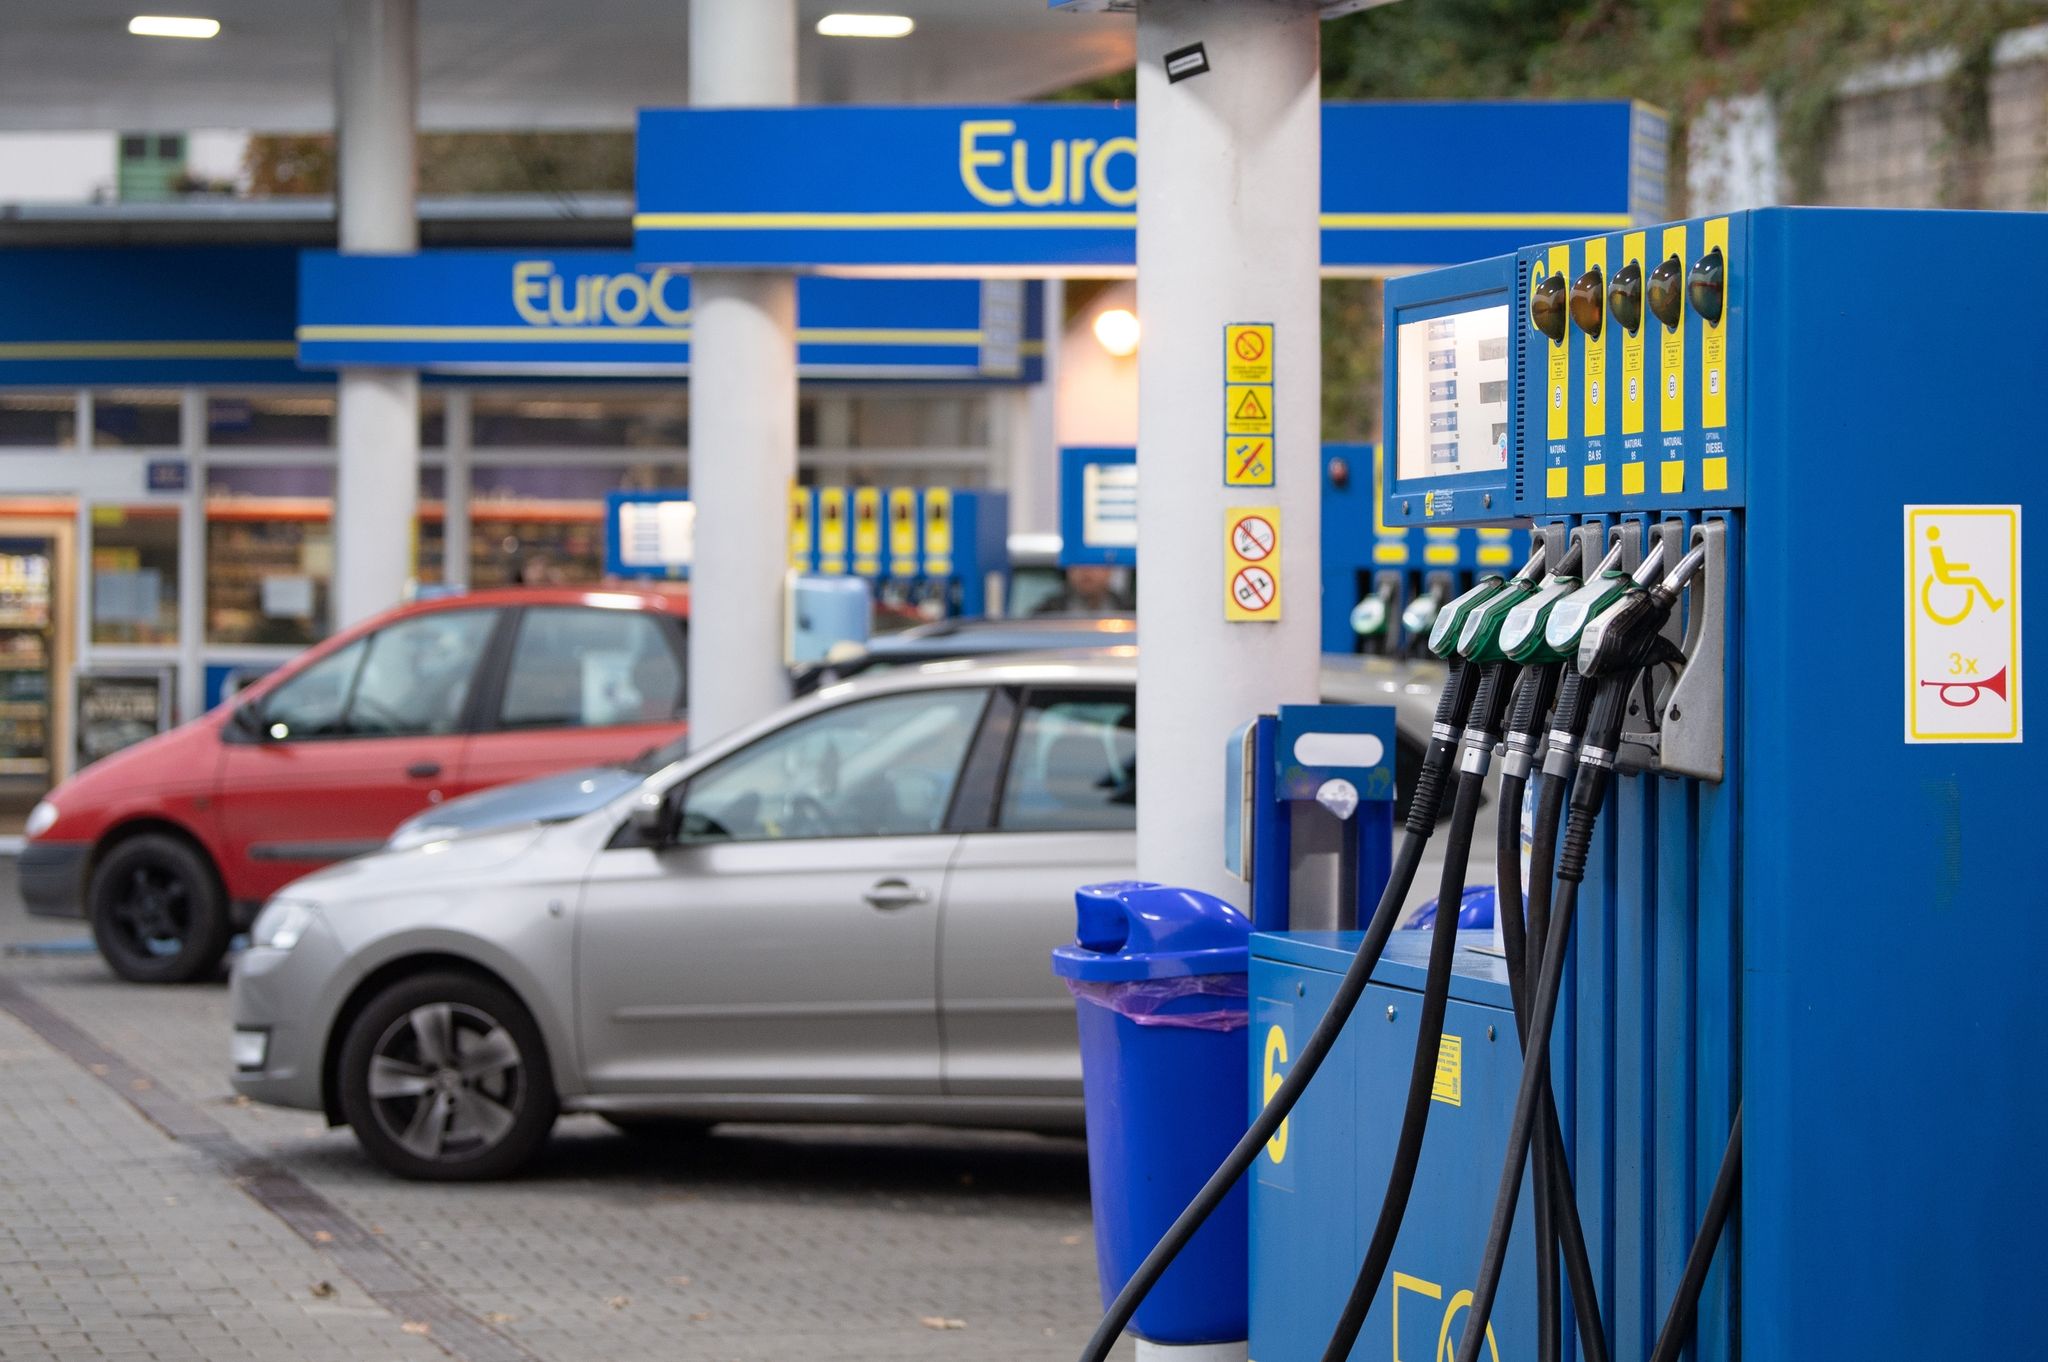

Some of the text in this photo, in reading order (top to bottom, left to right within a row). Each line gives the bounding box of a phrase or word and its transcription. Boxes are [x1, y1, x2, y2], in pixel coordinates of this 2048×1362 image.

[959, 119, 1136, 207] Euro
[1624, 438, 1643, 449] NATURAL
[1663, 436, 1683, 447] NATURAL
[1549, 444, 1567, 454] NATURAL
[1705, 442, 1724, 454] DIESEL
[1630, 451, 1636, 460] 95
[1670, 449, 1676, 459] 95
[1948, 652, 1979, 675] 3x
